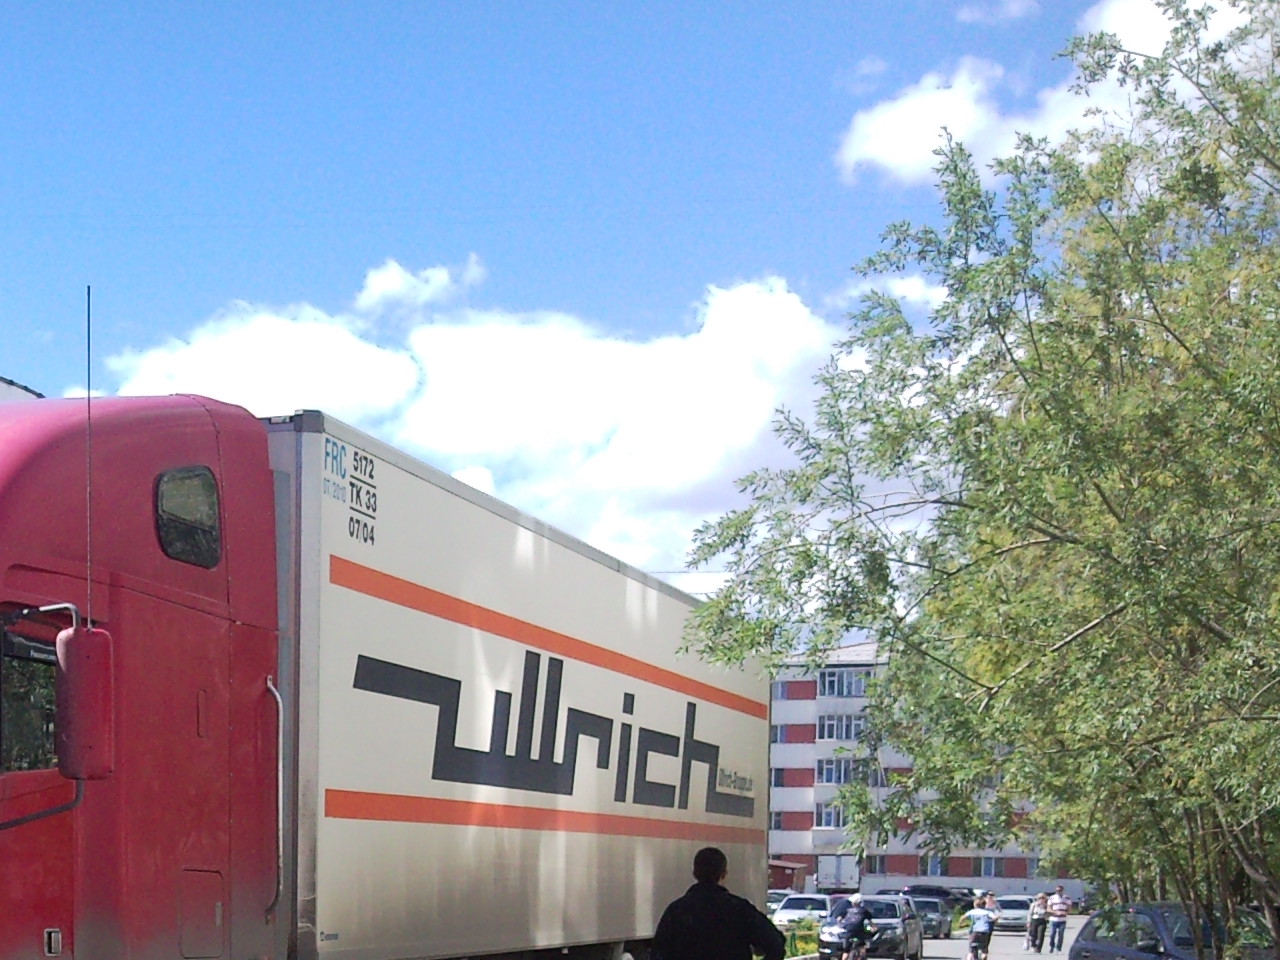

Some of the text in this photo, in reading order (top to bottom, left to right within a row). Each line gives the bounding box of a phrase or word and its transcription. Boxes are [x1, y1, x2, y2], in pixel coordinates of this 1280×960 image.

[324, 437, 347, 480] FRC
[353, 451, 375, 480] 5172
[349, 480, 377, 513] TK 33
